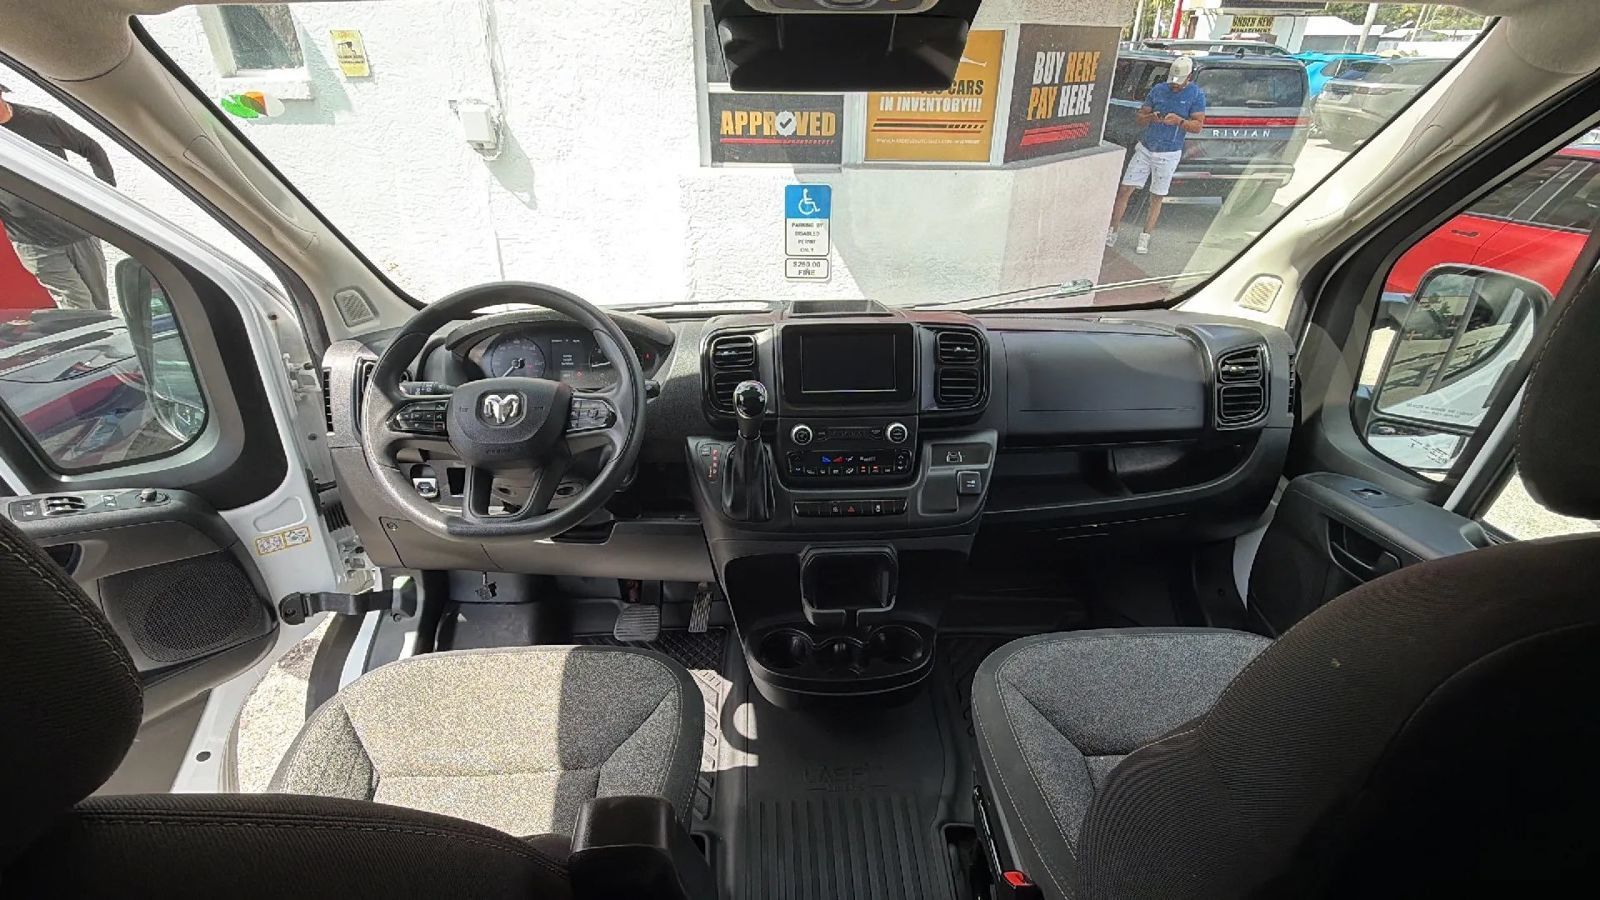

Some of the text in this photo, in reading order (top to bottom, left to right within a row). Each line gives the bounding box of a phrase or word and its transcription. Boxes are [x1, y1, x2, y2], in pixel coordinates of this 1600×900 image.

[1032, 51, 1100, 85] BUY HERE
[949, 79, 984, 96] CARS
[879, 96, 982, 113] IN INVENTORY!!!
[1026, 83, 1096, 121] PAY HERE
[1212, 129, 1271, 138] RIVIAN
